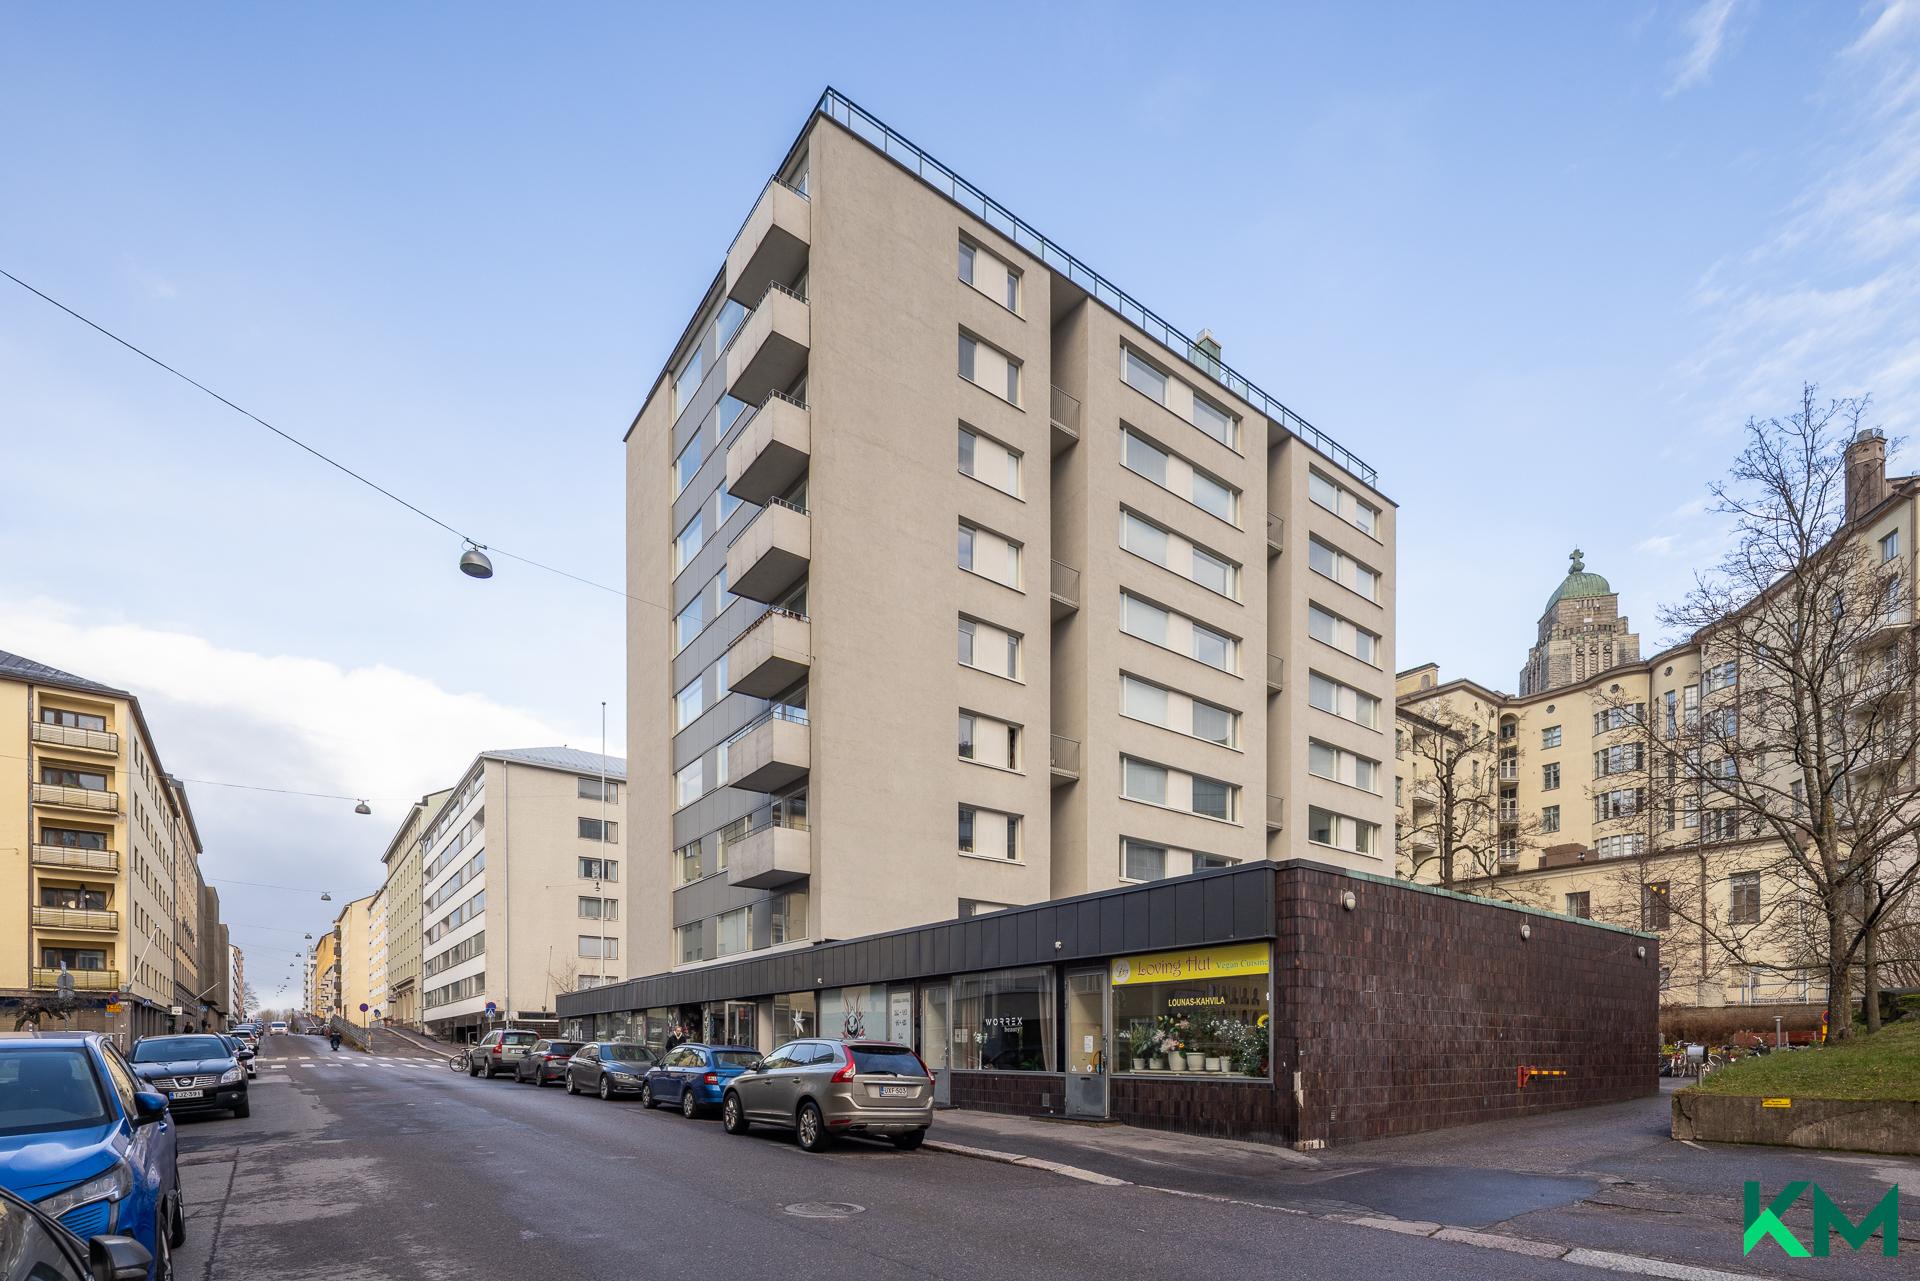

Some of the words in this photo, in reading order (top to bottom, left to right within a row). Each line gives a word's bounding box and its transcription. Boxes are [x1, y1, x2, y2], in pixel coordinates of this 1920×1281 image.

[1137, 958, 1181, 977] Loving
[1186, 955, 1211, 971] Hut
[1216, 960, 1239, 970] Vegan
[1240, 958, 1269, 968] Cuisine
[1168, 996, 1226, 1007] LOUNAS-KAHVILA
[985, 1016, 1023, 1026] WORREX
